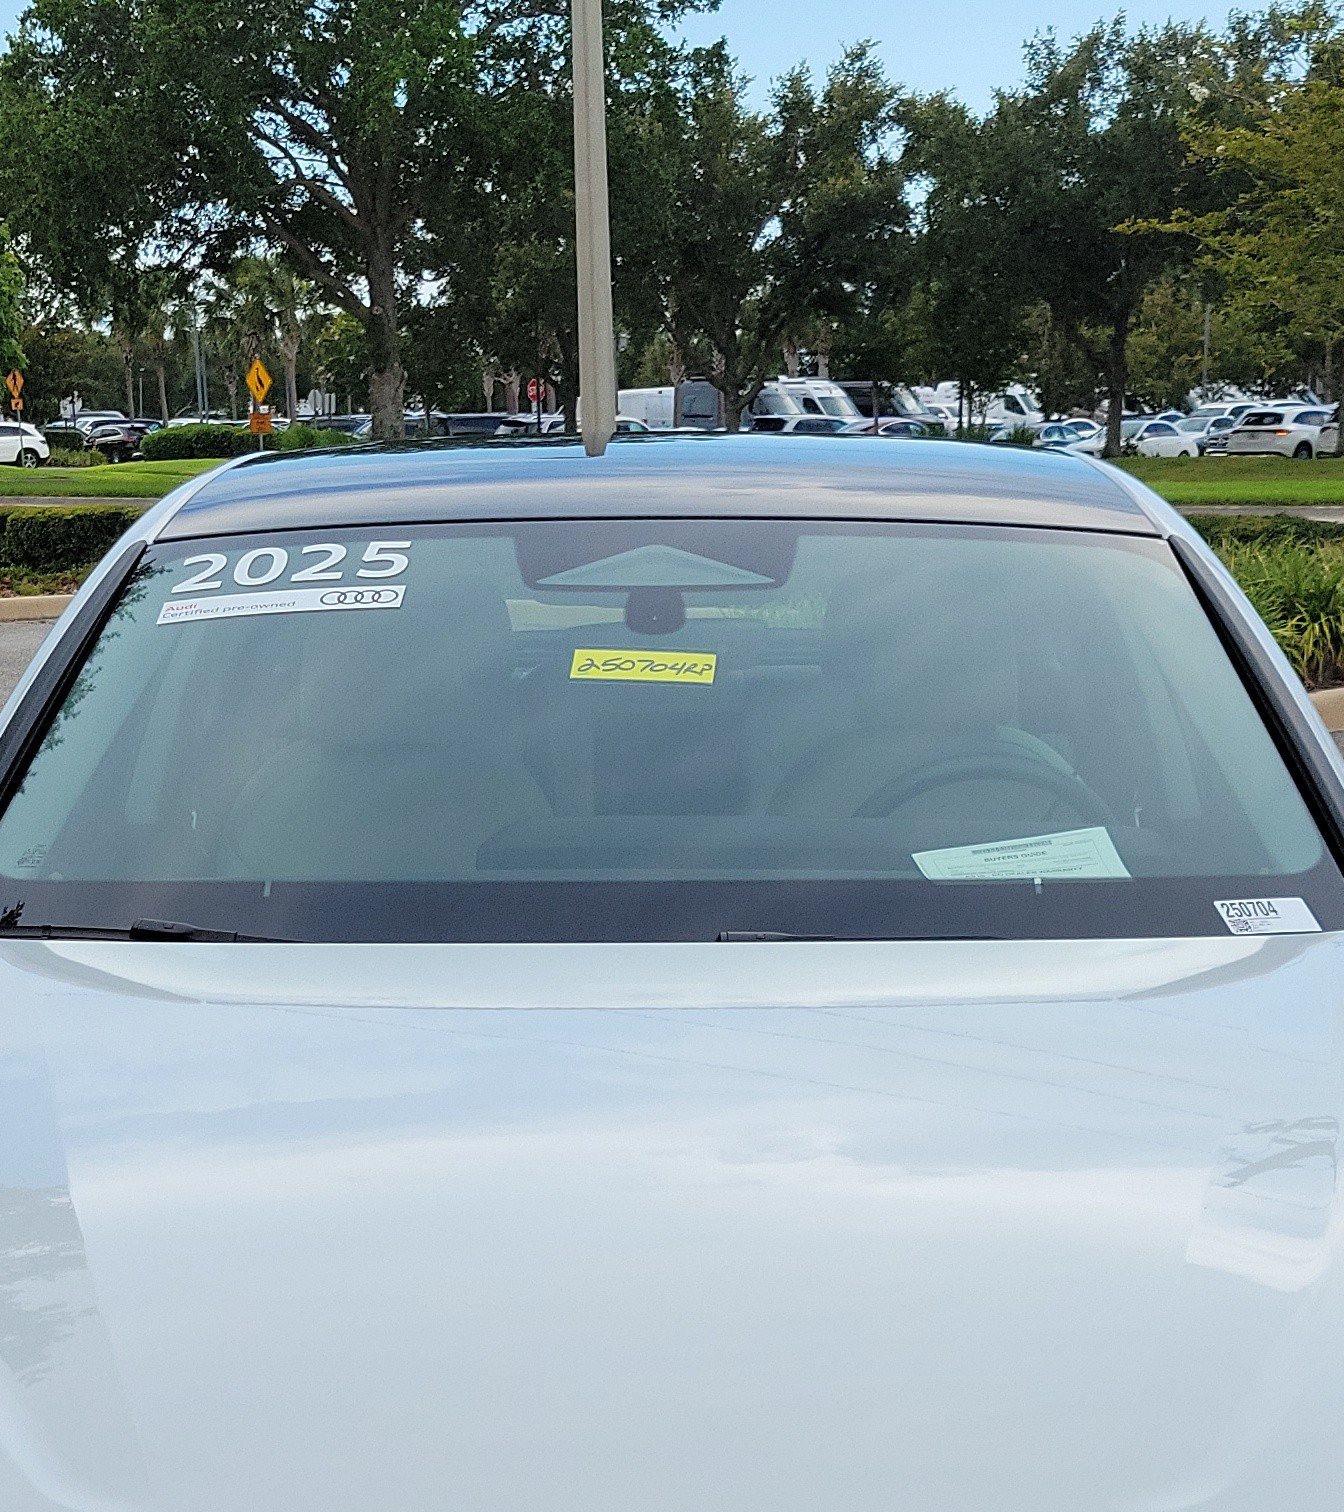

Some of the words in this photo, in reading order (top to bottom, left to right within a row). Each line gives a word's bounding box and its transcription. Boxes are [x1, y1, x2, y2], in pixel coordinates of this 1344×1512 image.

[171, 541, 412, 594] 2025
[162, 607, 219, 618] Certified
[222, 601, 296, 613] pre-owned
[165, 603, 198, 612] Audi
[577, 656, 713, 676] 250704RP
[1221, 901, 1278, 918] 250704
